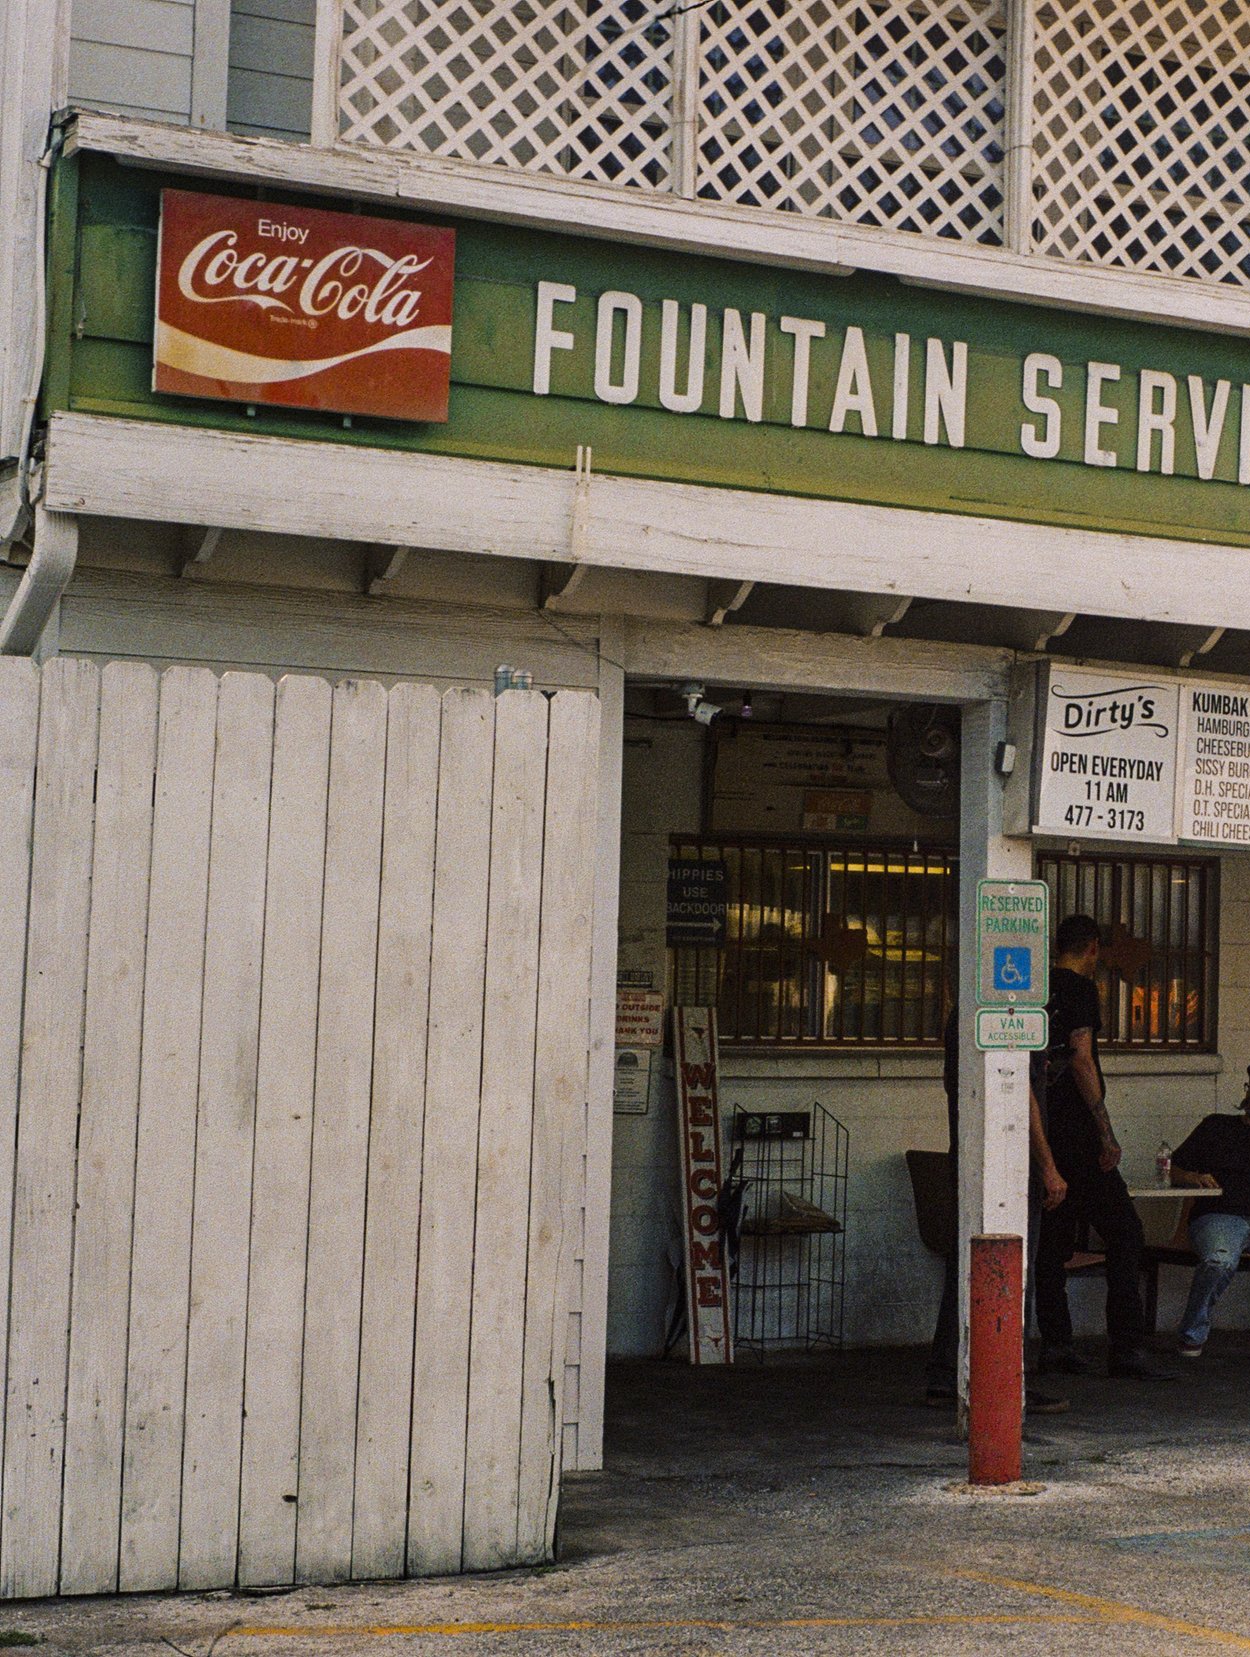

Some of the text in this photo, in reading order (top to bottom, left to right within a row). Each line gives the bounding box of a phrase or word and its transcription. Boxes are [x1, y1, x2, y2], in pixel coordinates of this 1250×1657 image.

[258, 219, 309, 244] Enjoy
[178, 230, 434, 326] Coca-Cola
[533, 280, 968, 448] FOUNTAIN
[1064, 695, 1155, 730] Dirty's
[1193, 692, 1248, 717] KUMBAK
[1051, 751, 1163, 782] OPEN EVERYDAY
[1195, 758, 1225, 775] SISSY
[1085, 781, 1128, 804] 11 AM
[1195, 779, 1215, 797] D.H.
[1193, 800, 1210, 816] O.T.
[1064, 805, 1094, 826] 477
[1108, 809, 1144, 831] 3173
[1192, 820, 1219, 838] CHILI
[668, 867, 724, 882] HIPPIES
[682, 886, 709, 898] USE
[667, 902, 725, 915] BACKDOOR
[982, 895, 1043, 912] RESERVED
[985, 917, 1040, 934] PARKING
[622, 1004, 660, 1012] OUTSIDE
[1000, 1018, 1024, 1029] VAN
[988, 1031, 1036, 1041] ACCESSIBLE
[680, 1062, 722, 1307] WELCOME
